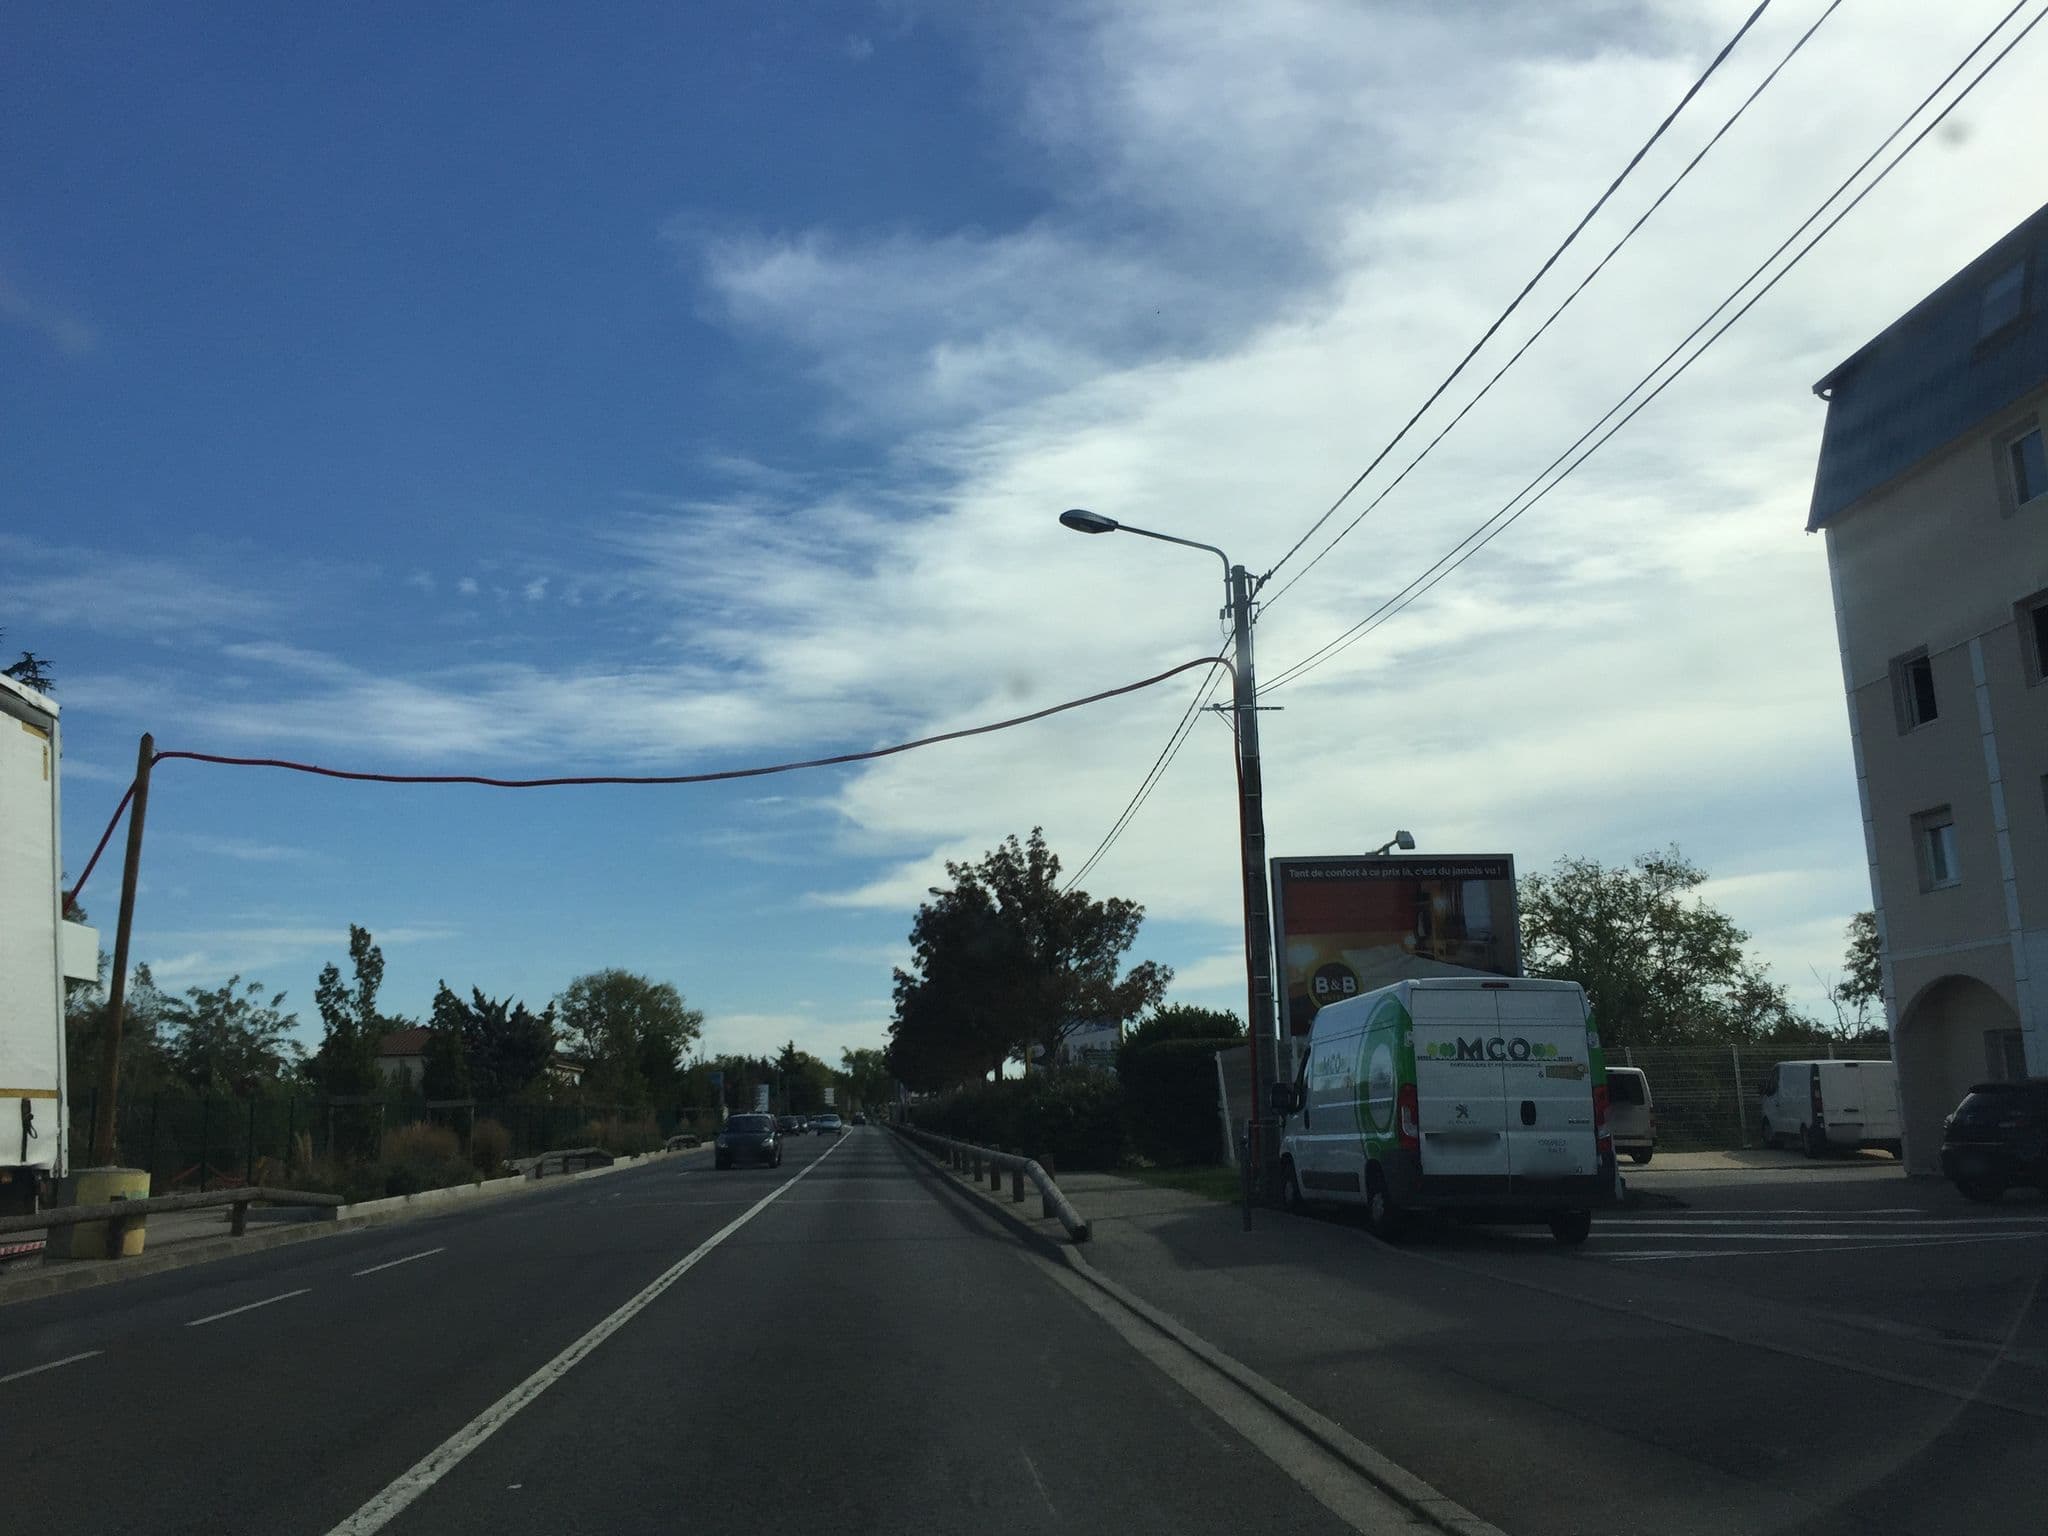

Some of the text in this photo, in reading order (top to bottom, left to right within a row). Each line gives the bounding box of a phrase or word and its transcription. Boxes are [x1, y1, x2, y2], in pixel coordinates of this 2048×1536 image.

[1289, 869, 1309, 878] Tant
[1311, 868, 1323, 878] de
[1325, 868, 1360, 878] confort
[1369, 869, 1380, 877] ce
[1382, 867, 1401, 879] prix
[1415, 867, 1436, 876] c'est
[1439, 866, 1450, 875] du
[1452, 866, 1482, 877] jamais
[1315, 975, 1356, 994] B&B
[1456, 1036, 1531, 1060] MCO
